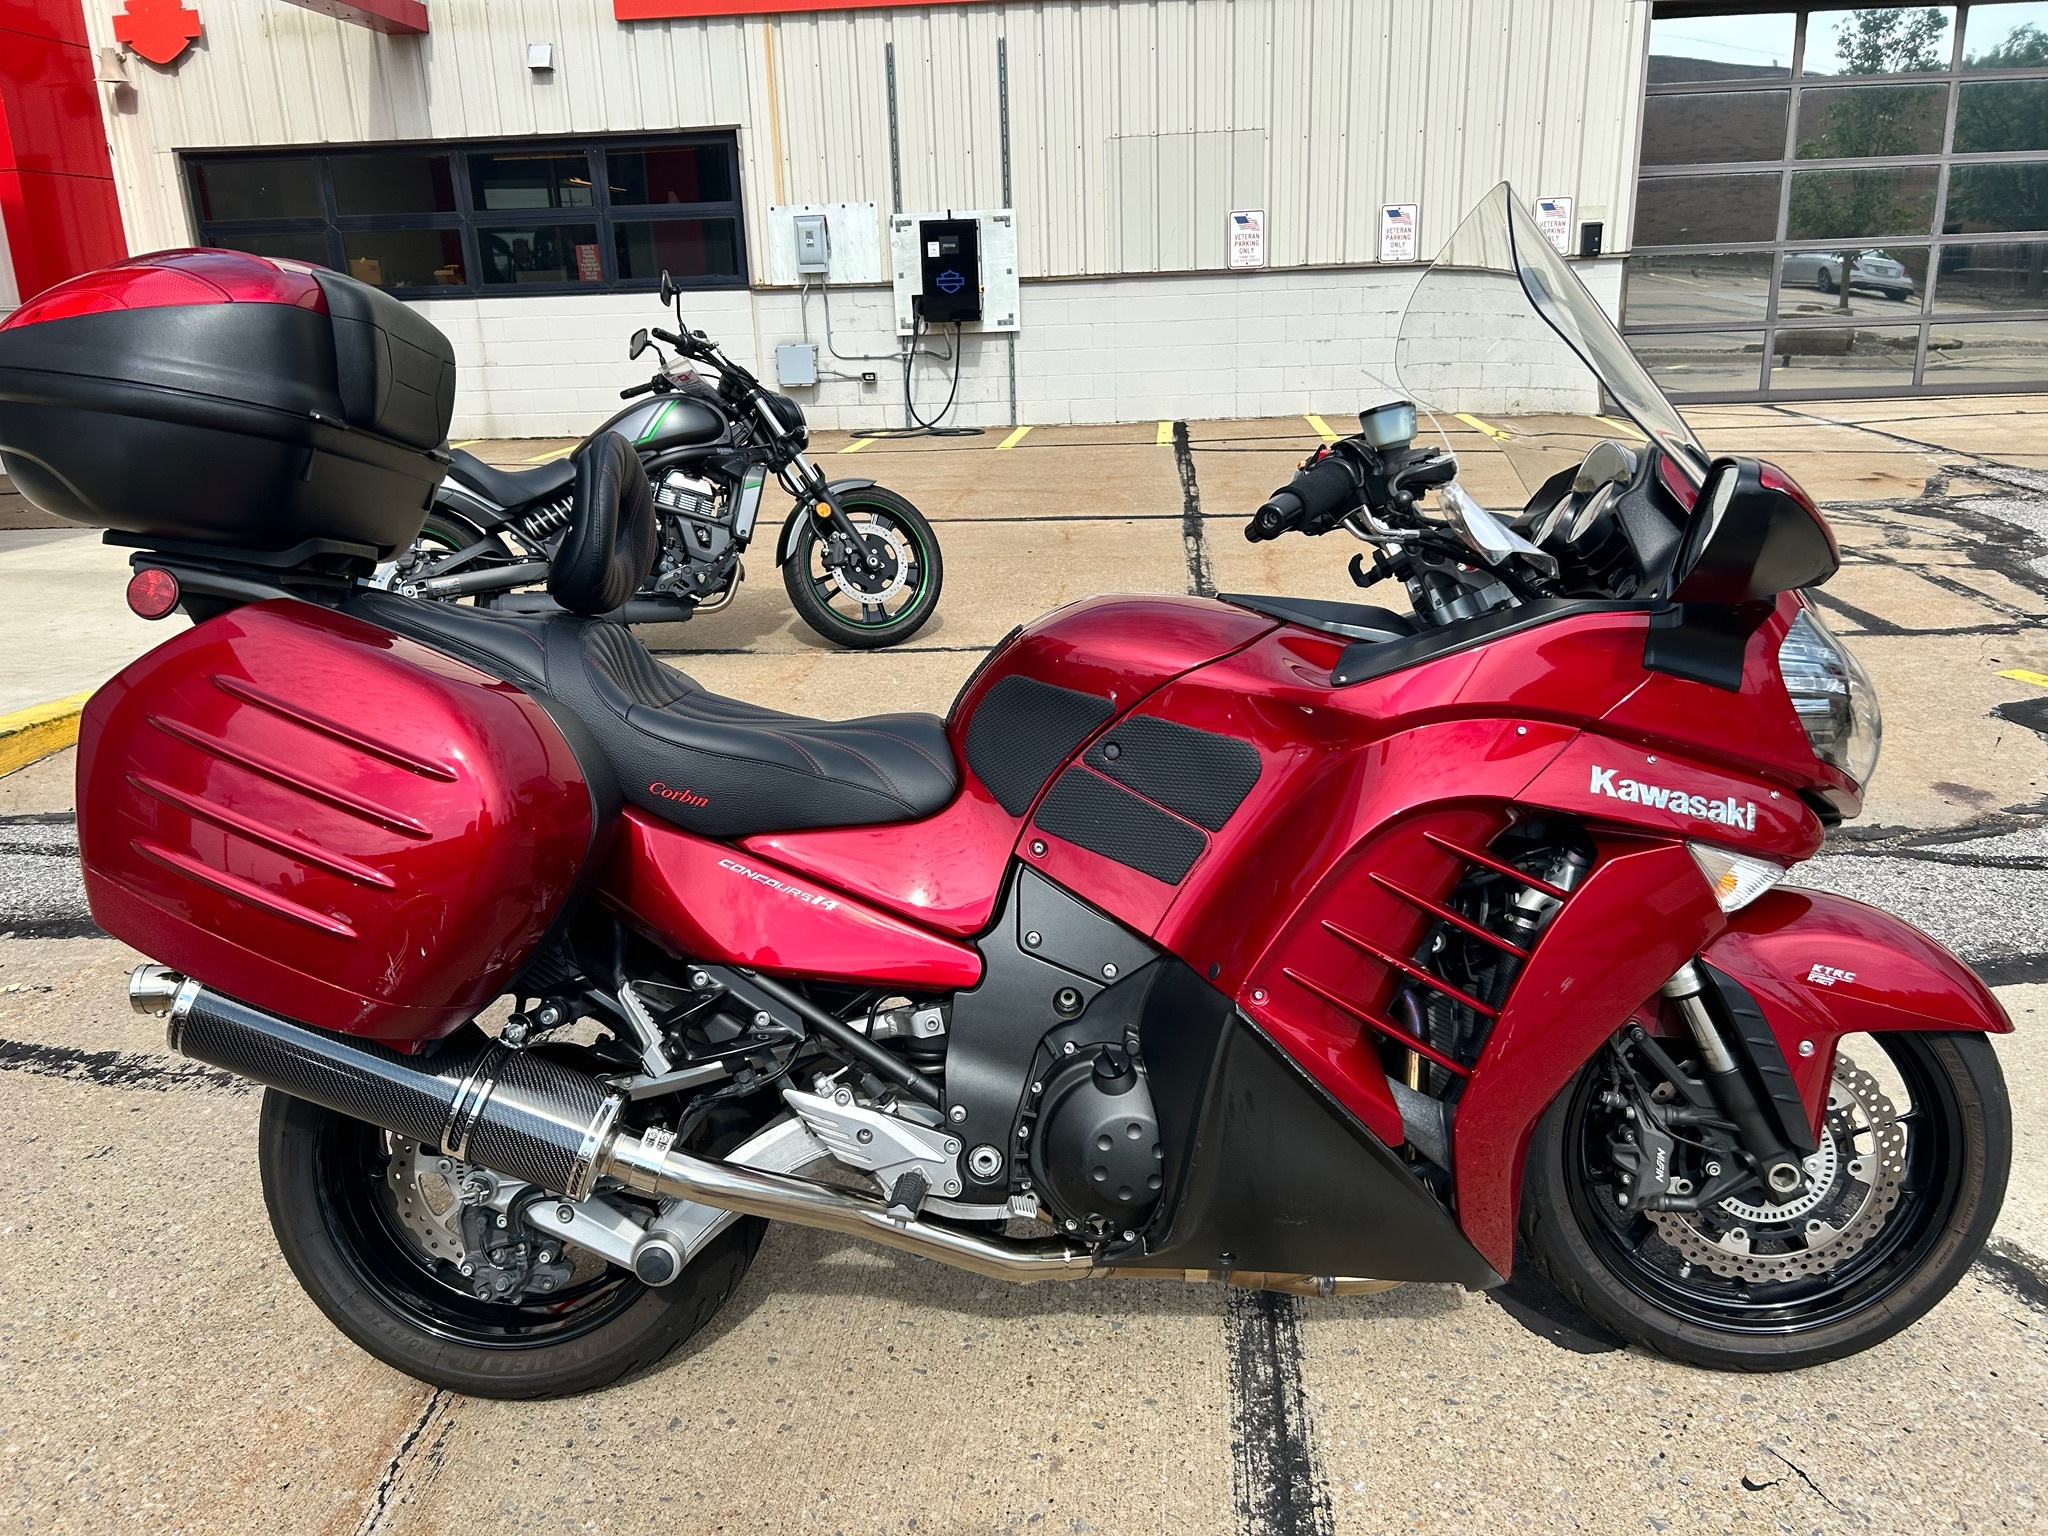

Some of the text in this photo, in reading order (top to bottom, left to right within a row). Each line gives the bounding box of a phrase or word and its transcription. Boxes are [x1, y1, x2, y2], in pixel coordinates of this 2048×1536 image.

[648, 781, 709, 808] Corbin
[1589, 764, 1756, 832] Kawasaki
[1811, 963, 1856, 981] KTRC
